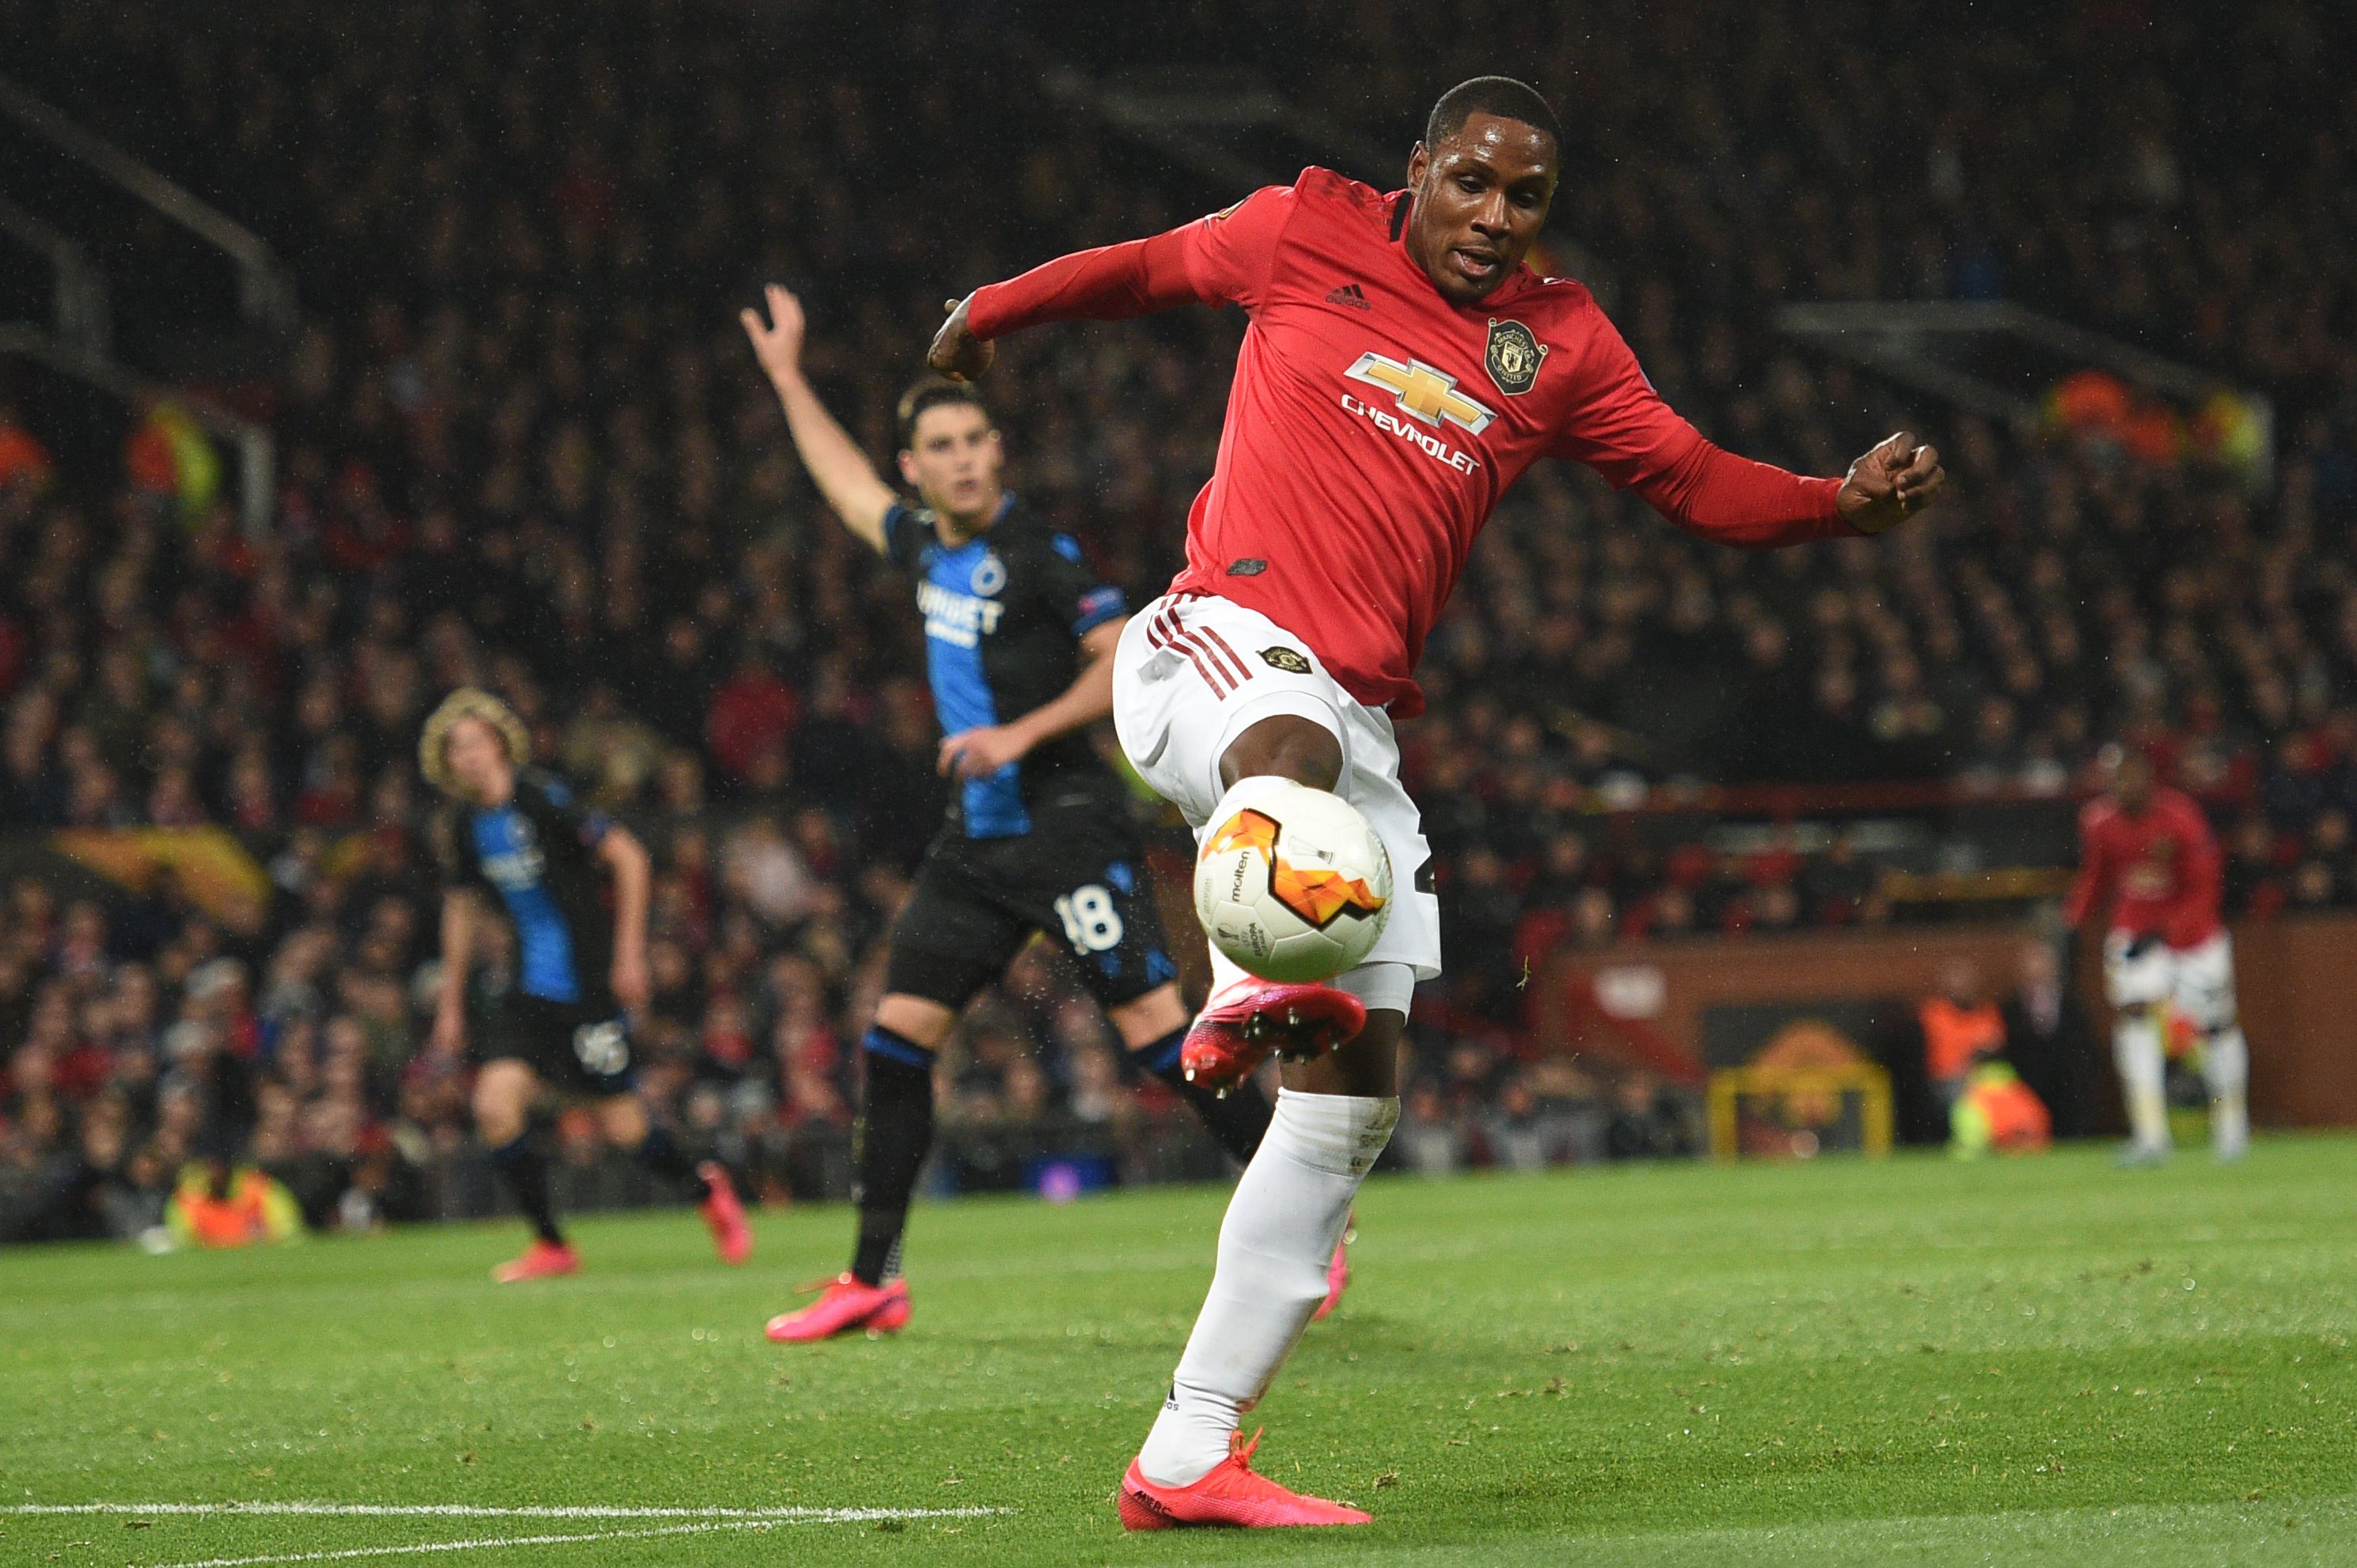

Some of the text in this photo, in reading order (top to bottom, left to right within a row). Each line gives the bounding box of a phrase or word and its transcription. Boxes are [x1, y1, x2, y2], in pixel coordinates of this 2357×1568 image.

[1497, 365, 1523, 381] UNITED
[1341, 394, 1481, 475] CHEVROLET
[1231, 851, 1250, 902] molten
[1054, 884, 1124, 956] 18
[1250, 922, 1263, 958] EUROPA
